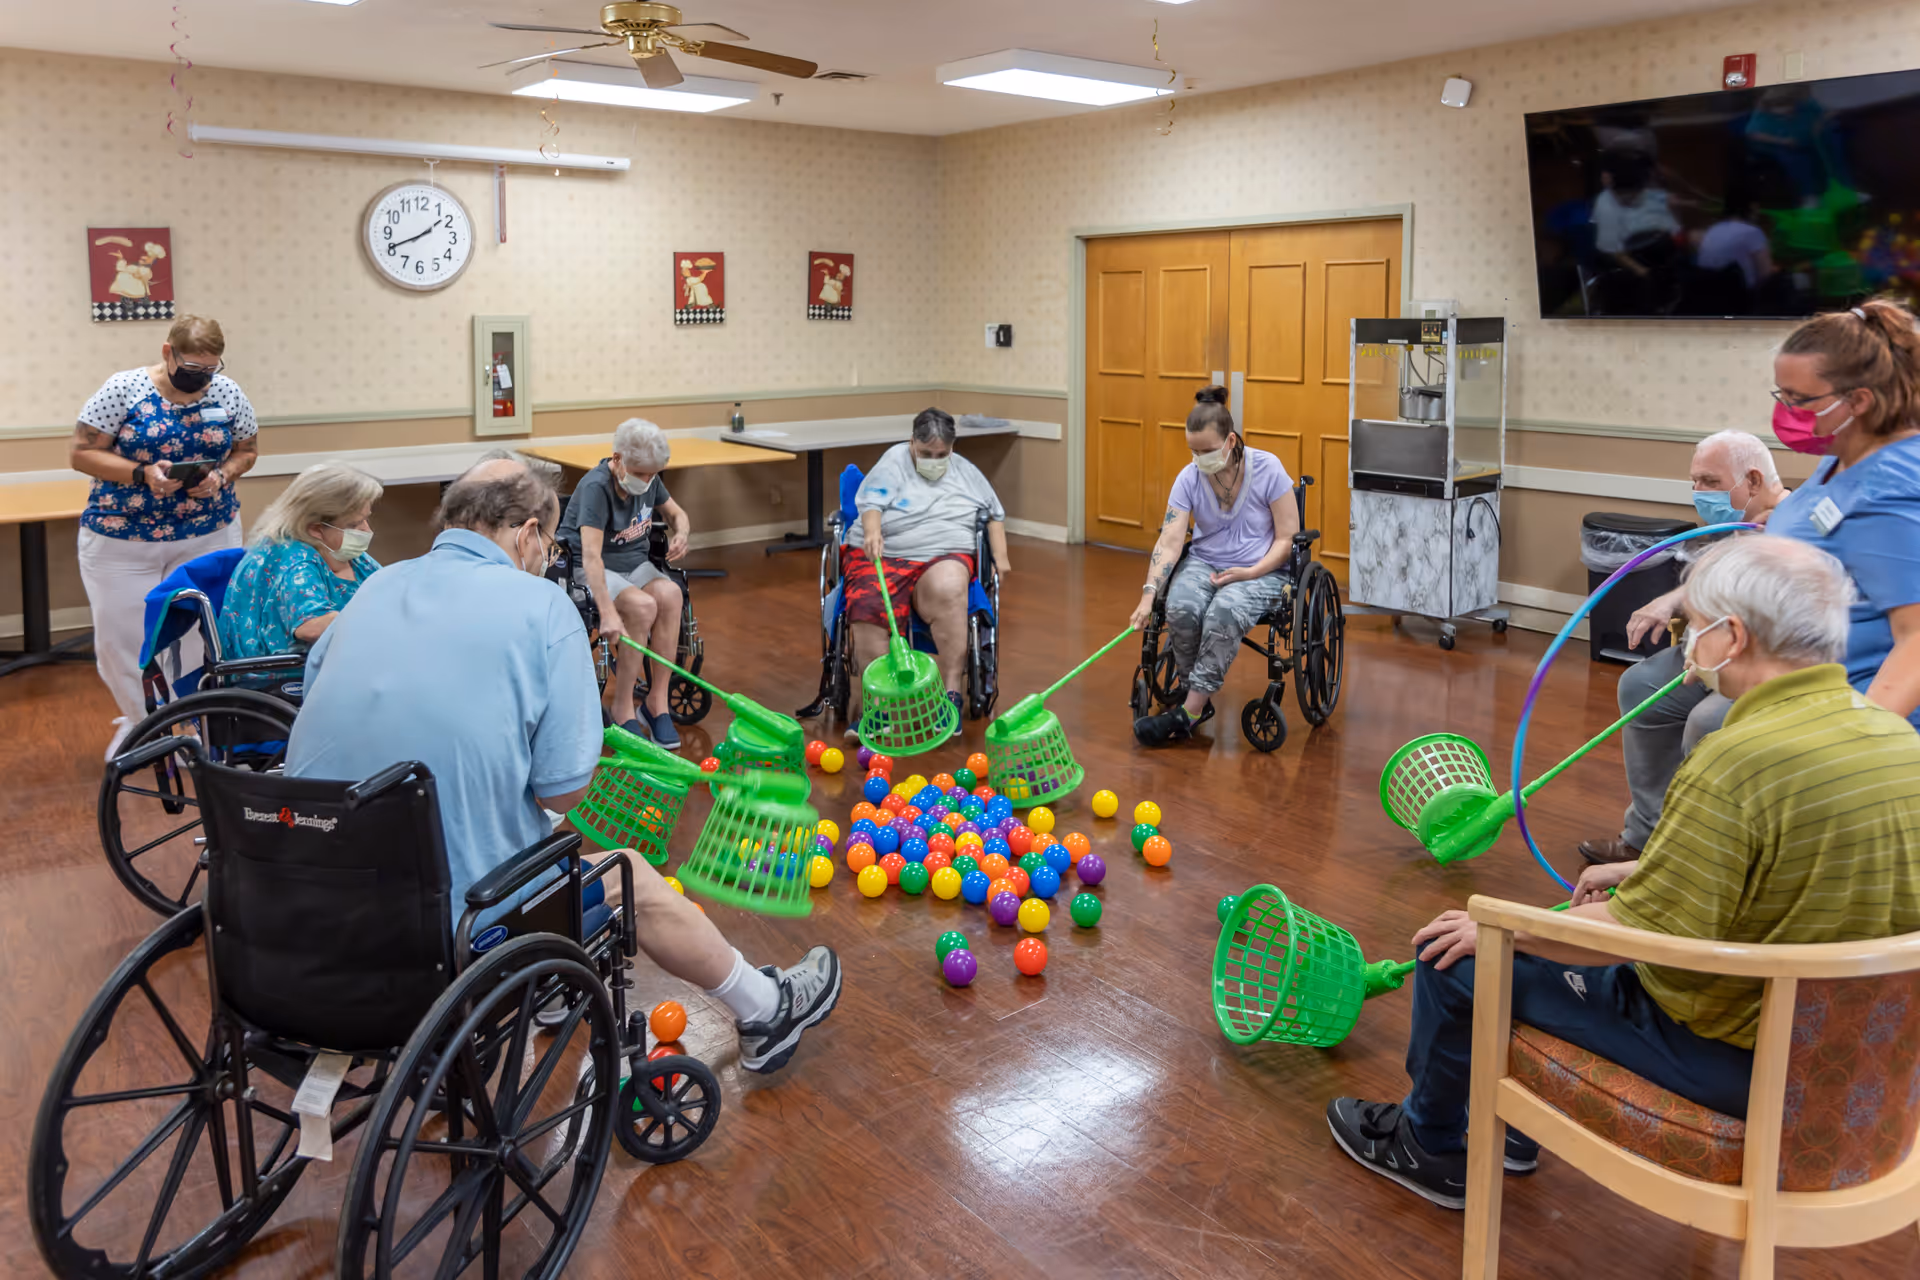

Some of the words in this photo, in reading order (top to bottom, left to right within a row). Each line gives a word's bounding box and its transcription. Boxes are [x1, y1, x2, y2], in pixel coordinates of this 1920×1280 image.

[400, 198, 411, 213] 11
[414, 196, 430, 211] 12
[435, 202, 442, 217] 1
[386, 209, 400, 224] 10
[444, 214, 453, 228] 2
[383, 226, 392, 240] 9
[448, 231, 457, 245] 3
[387, 242, 396, 256] 8
[443, 247, 452, 261] 4
[400, 255, 410, 269] 7
[415, 260, 424, 274] 6
[432, 257, 440, 272] 5
